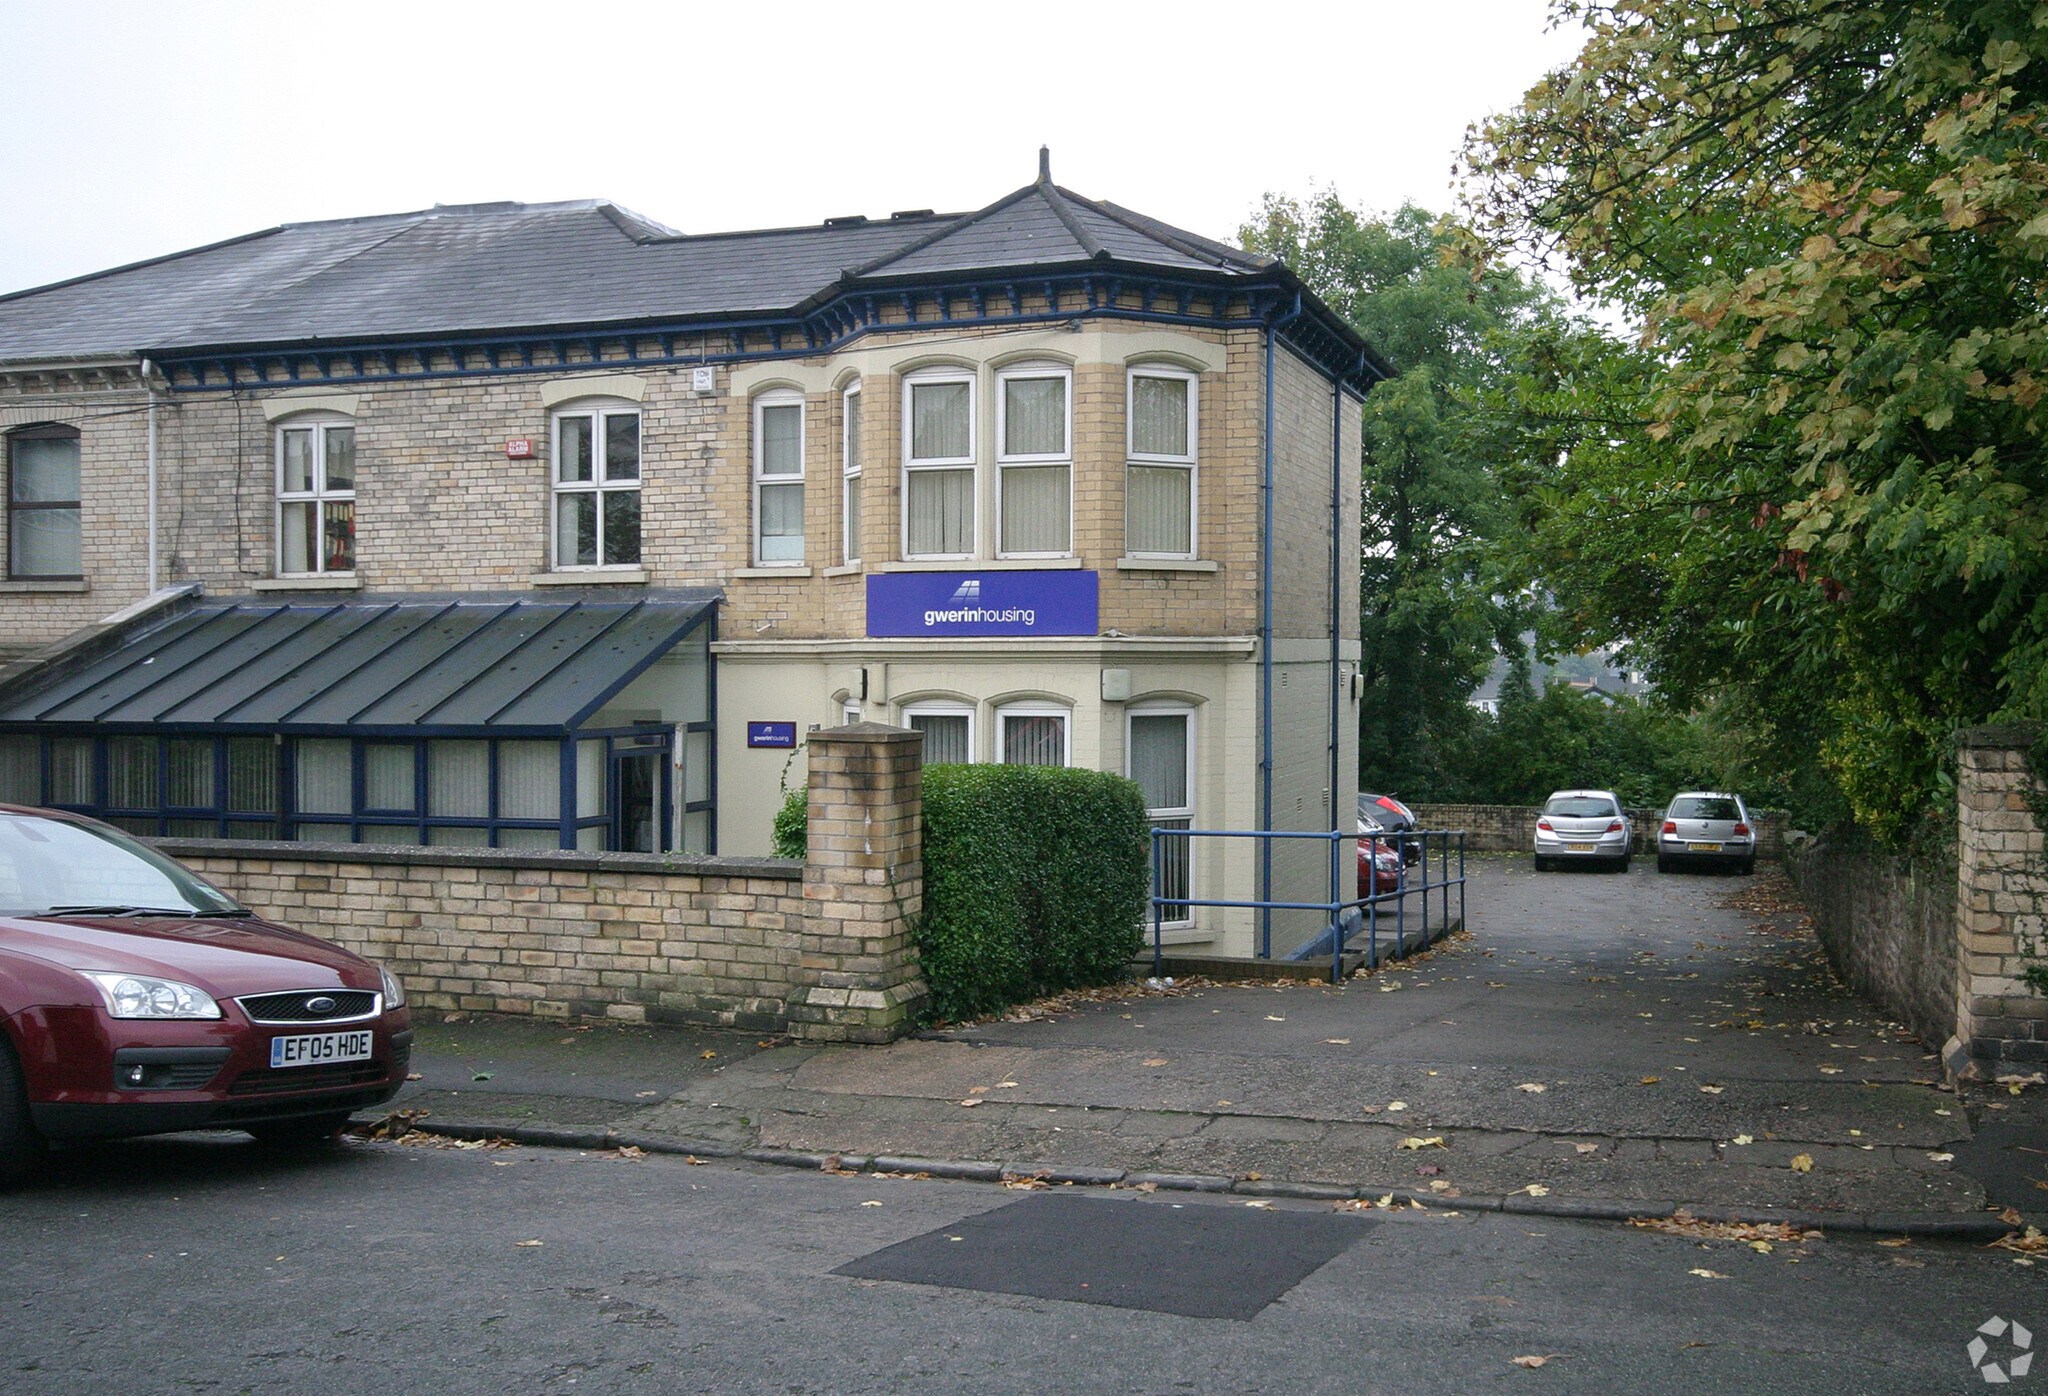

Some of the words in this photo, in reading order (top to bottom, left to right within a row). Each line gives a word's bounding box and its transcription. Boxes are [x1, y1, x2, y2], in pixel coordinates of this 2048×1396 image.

[924, 606, 1035, 626] gwerinhousing
[284, 1037, 334, 1061] EF05
[337, 1033, 369, 1056] HDE
